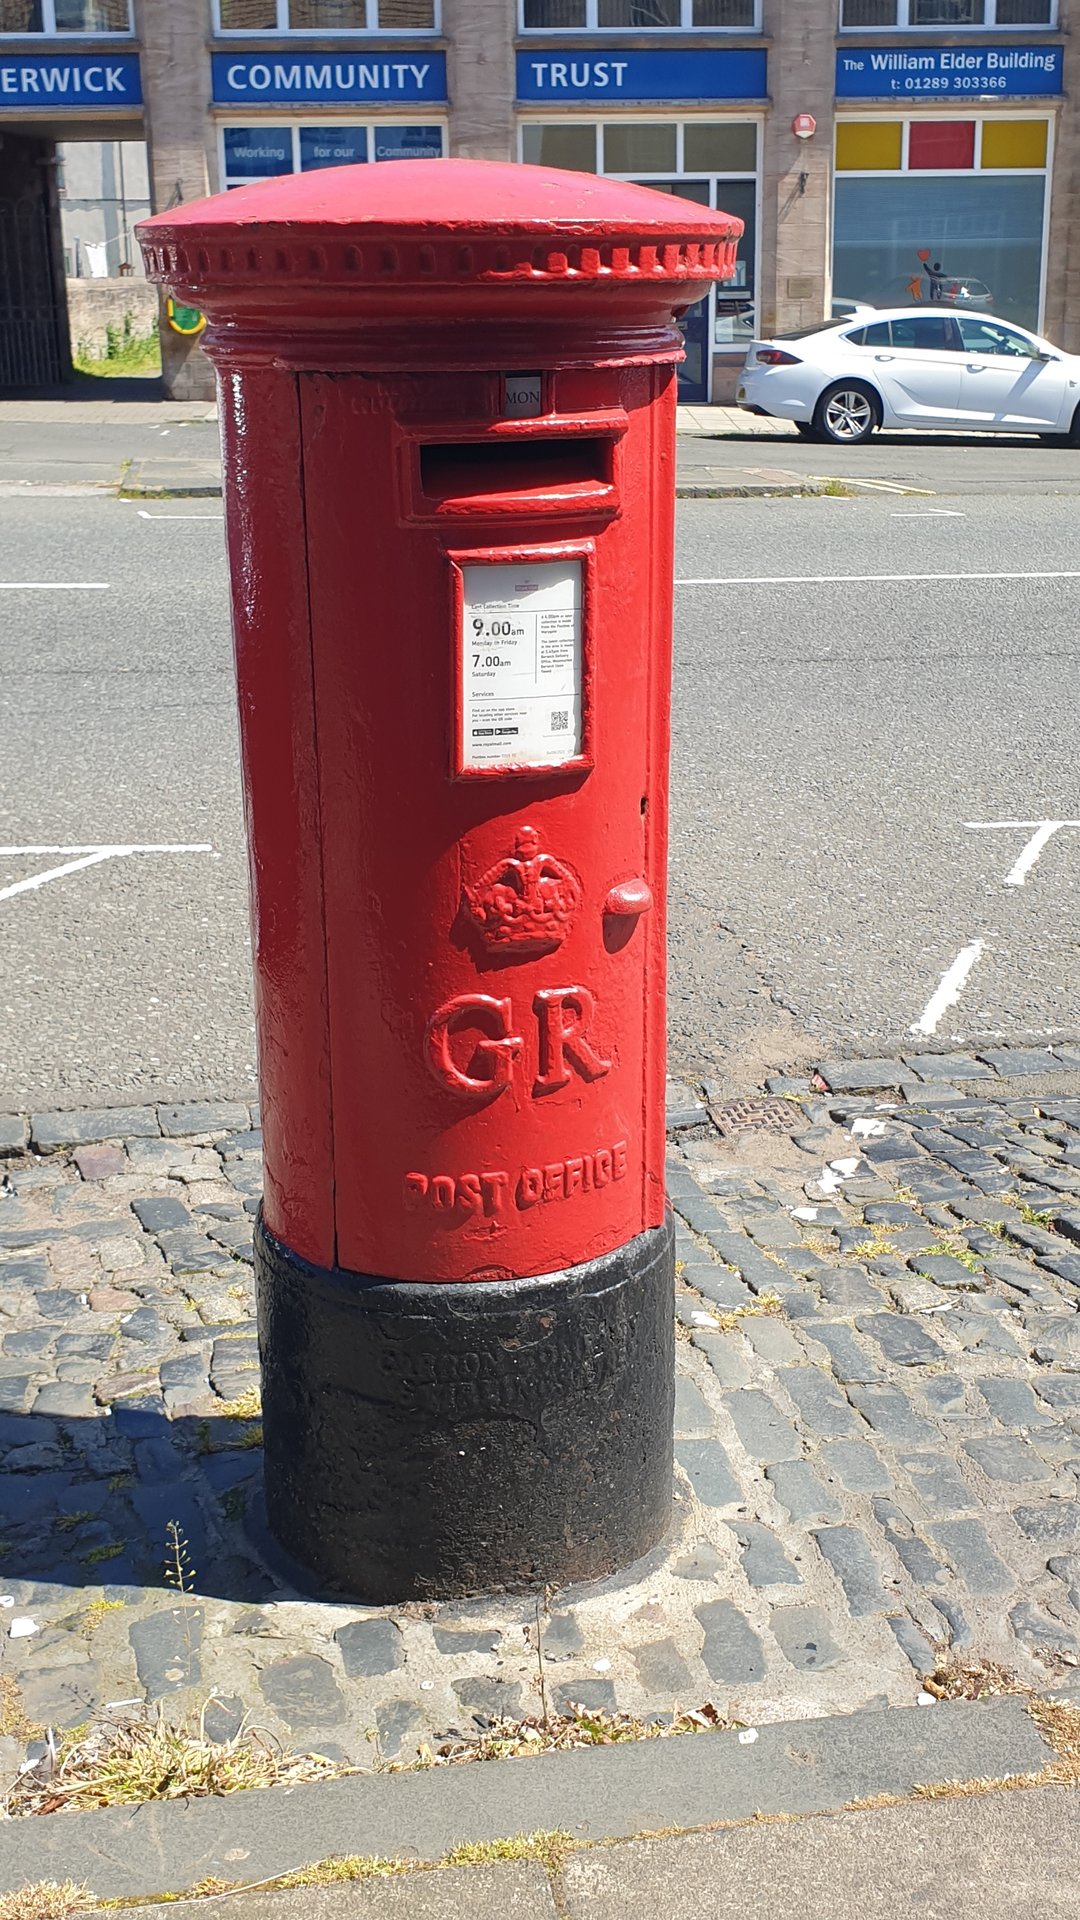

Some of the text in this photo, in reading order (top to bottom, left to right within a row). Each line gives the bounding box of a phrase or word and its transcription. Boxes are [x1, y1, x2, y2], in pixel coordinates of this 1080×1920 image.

[843, 52, 1056, 72] The William Elder Building
[227, 64, 430, 90] COMMUNITY
[530, 62, 629, 88] TRUST
[890, 76, 1007, 90] t: 01289 303366
[233, 145, 441, 160] Working for our Community
[505, 391, 541, 405] MON
[472, 618, 525, 637] 9.00am
[501, 639, 518, 647] Friday
[472, 654, 512, 668] 7.00am
[427, 984, 612, 1099] GR
[404, 1140, 628, 1211] POST OFFICE
